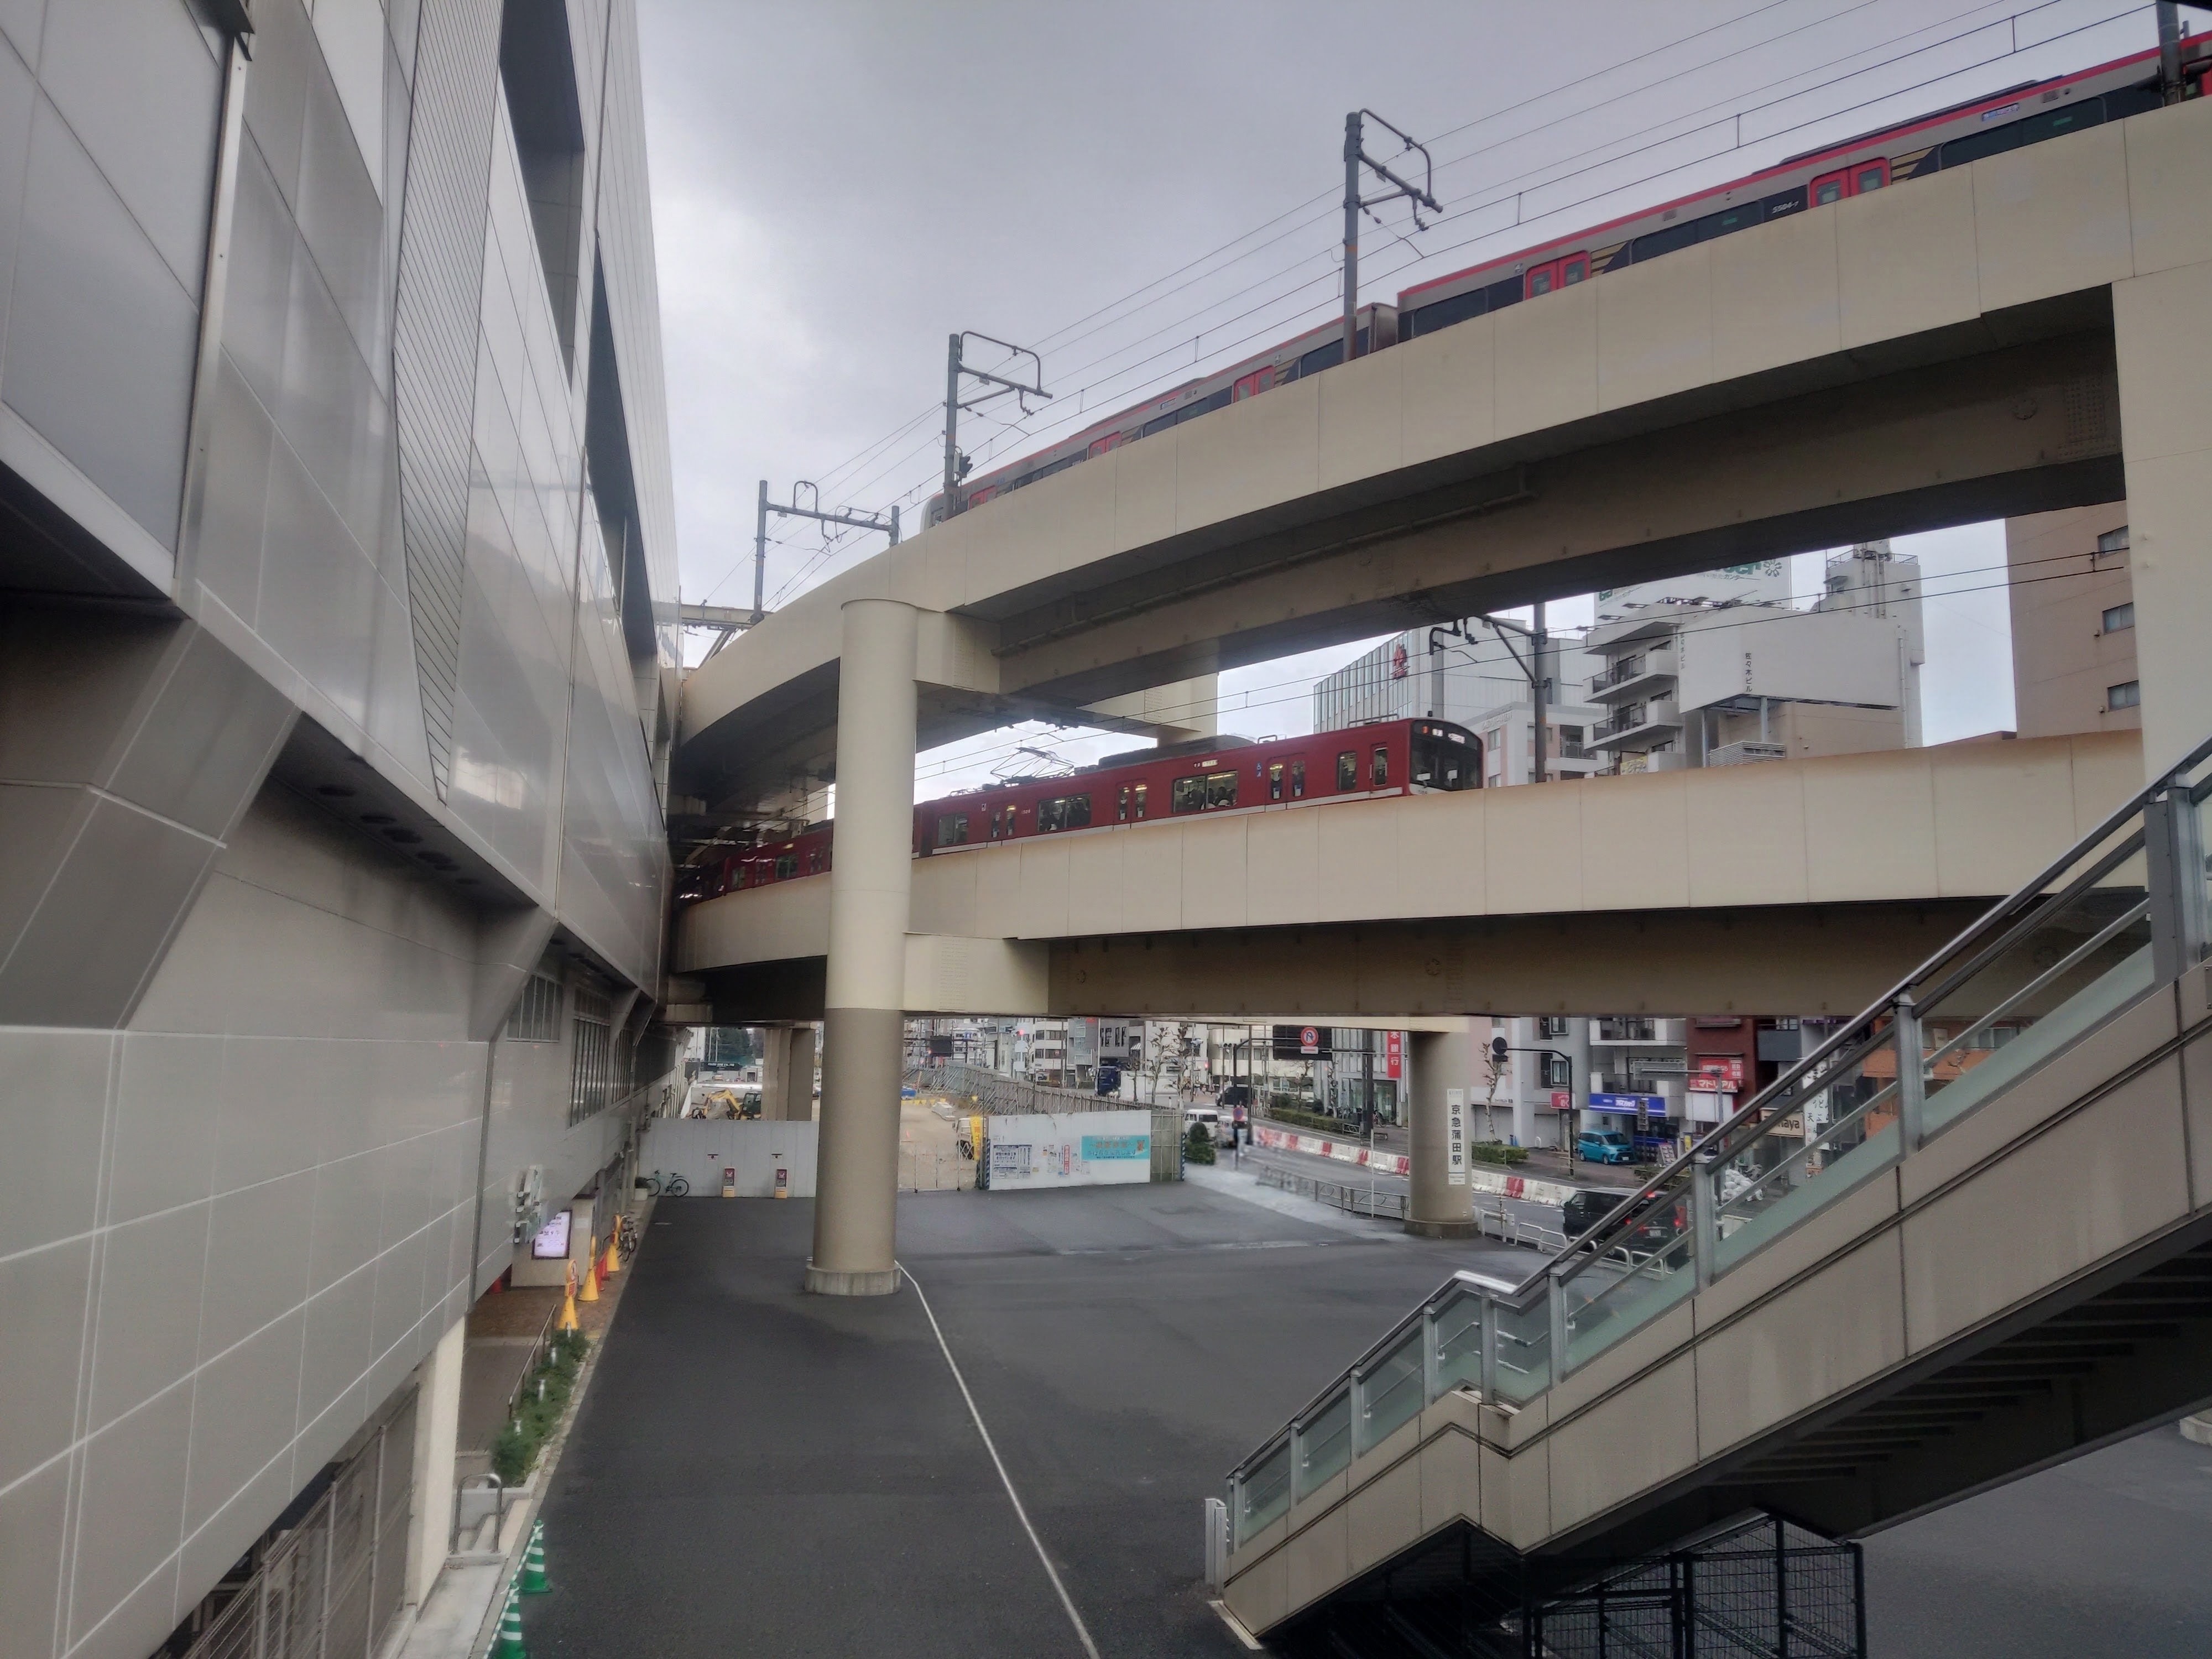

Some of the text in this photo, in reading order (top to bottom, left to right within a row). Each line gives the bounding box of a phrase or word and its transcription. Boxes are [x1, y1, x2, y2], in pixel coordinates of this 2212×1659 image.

[1451, 1105, 1462, 1165] 京急蒲田駅
